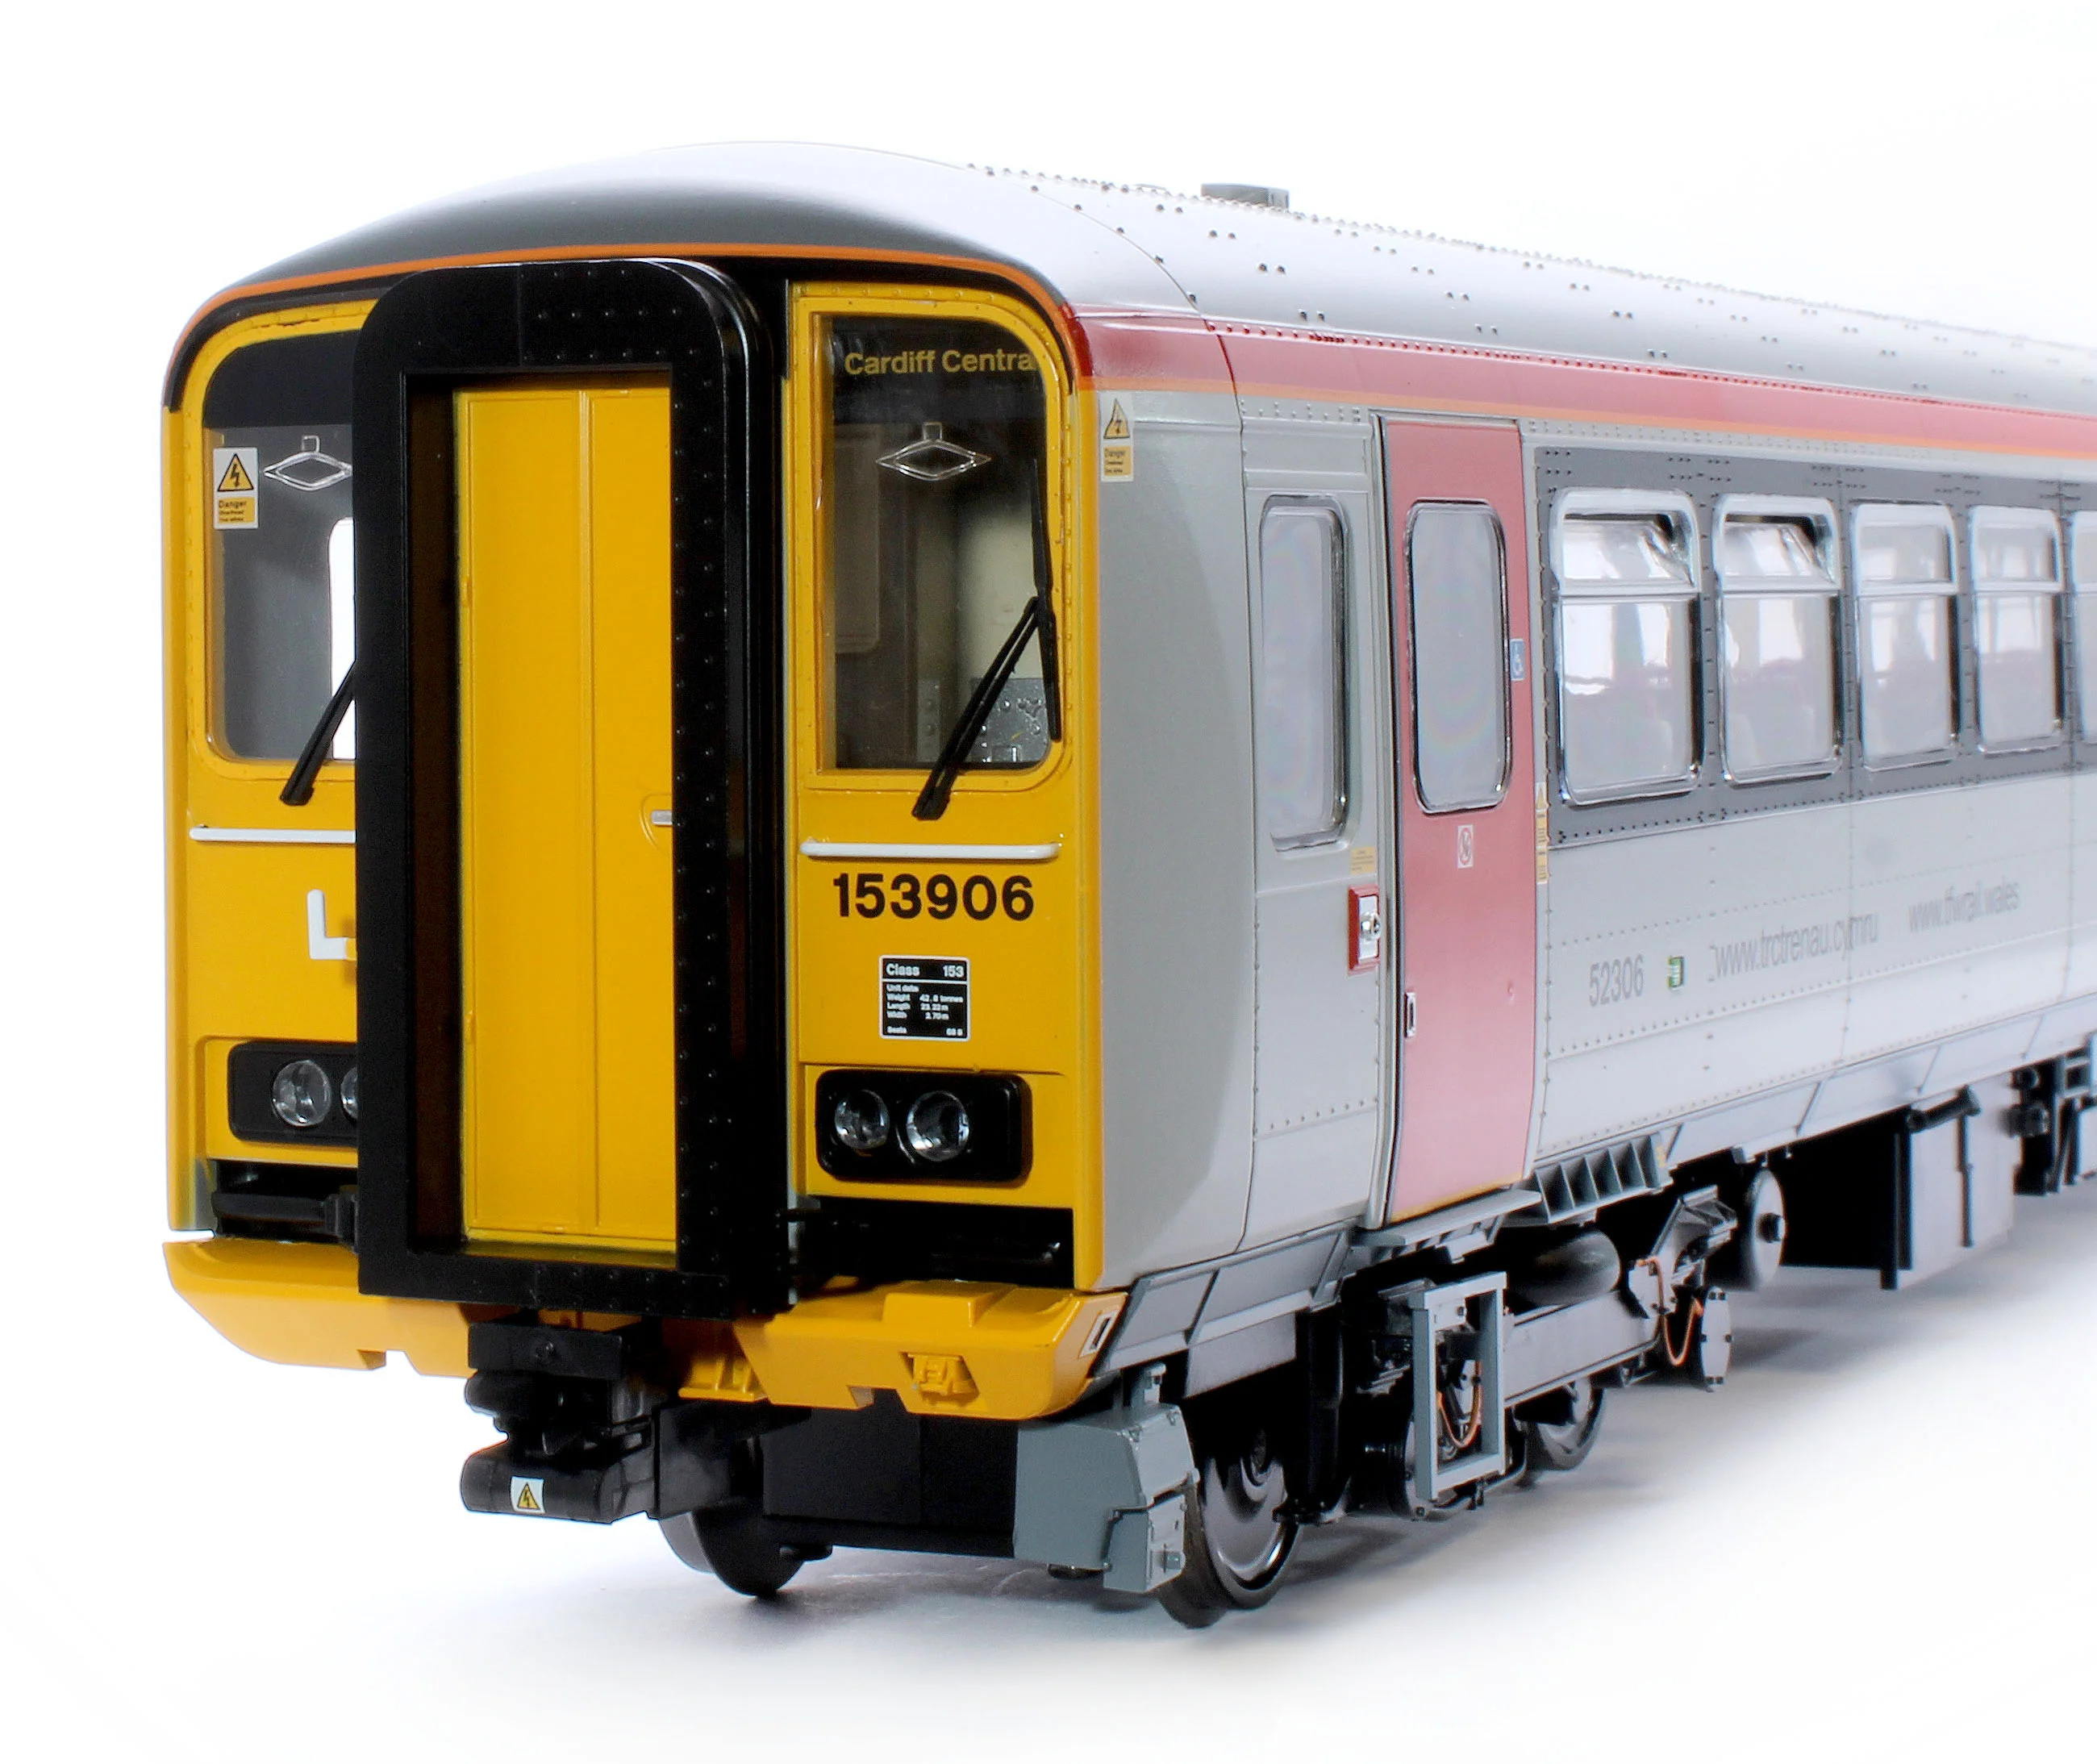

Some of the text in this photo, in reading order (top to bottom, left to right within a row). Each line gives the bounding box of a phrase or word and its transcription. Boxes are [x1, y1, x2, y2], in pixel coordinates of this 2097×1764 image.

[844, 349, 936, 375] Cardiff
[833, 873, 1034, 921] 153906
[886, 963, 965, 978] Class 153
[1589, 953, 1644, 1007] 52306
